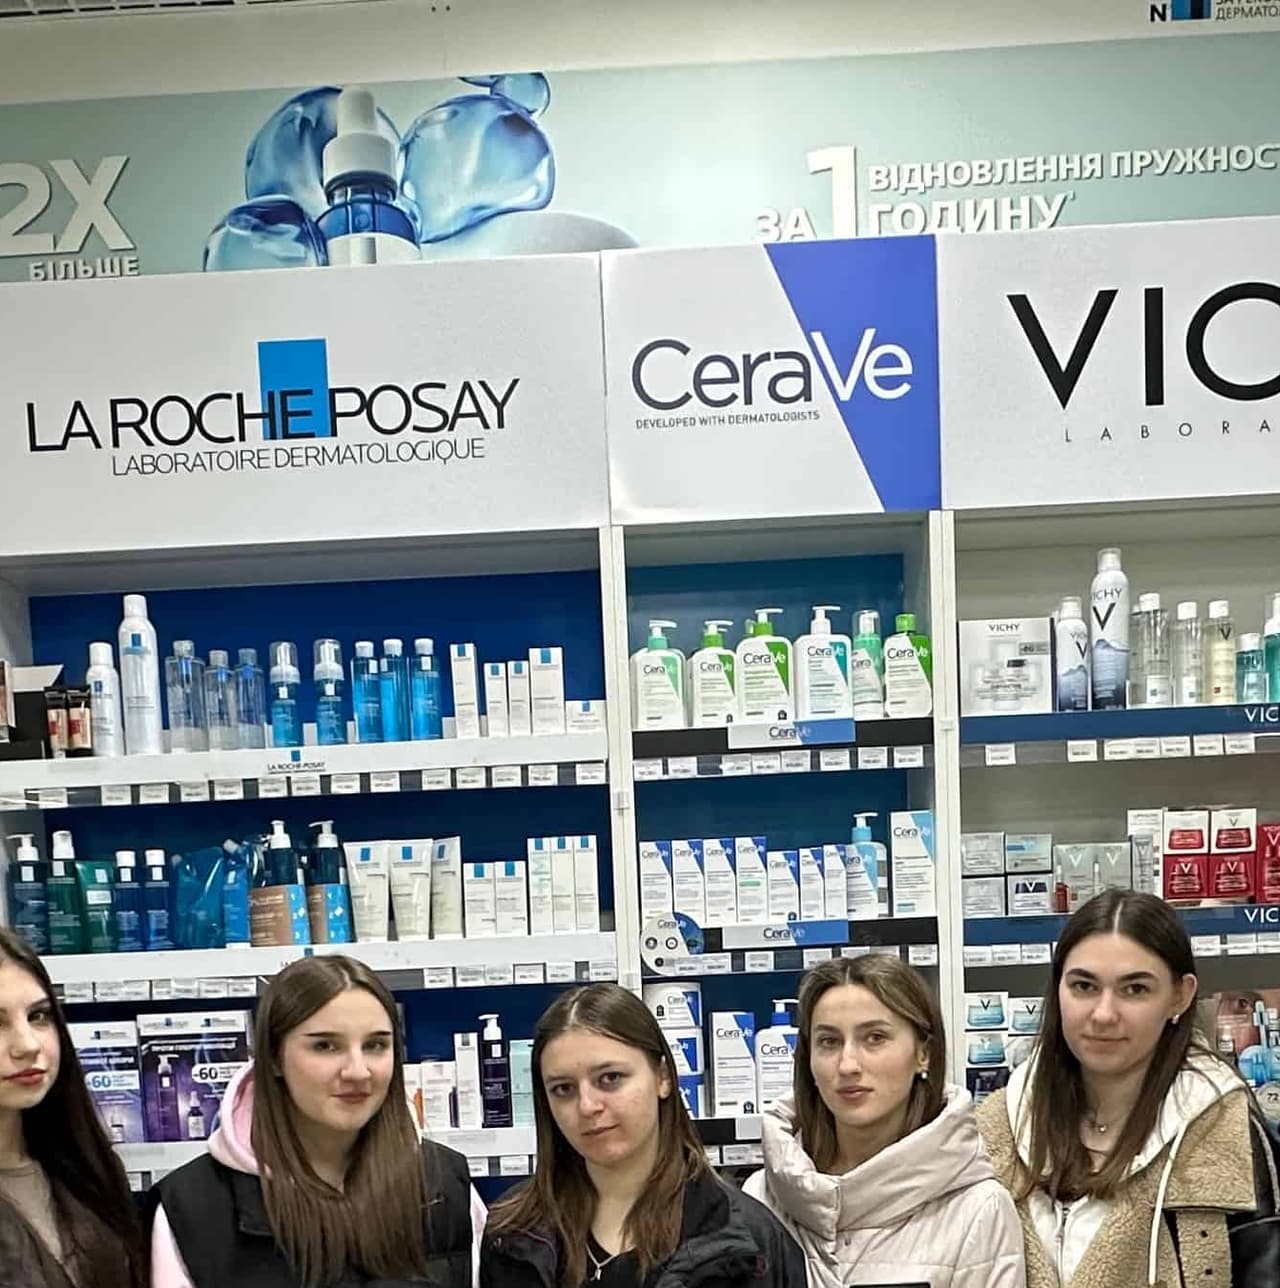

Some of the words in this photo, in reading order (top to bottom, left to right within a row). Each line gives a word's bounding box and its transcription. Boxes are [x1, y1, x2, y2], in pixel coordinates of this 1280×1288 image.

[867, 152, 1104, 195] ВІДНОВЛЕННЯ
[806, 144, 858, 238] 1
[28, 255, 140, 282] БІЛЬШЕ
[631, 327, 914, 411] CeraVe
[25, 400, 103, 453] LA
[109, 386, 317, 449] ROCHE
[326, 377, 521, 438] POSAY
[635, 418, 697, 430] DEVELOPED
[698, 415, 726, 427] WITH
[727, 409, 821, 426] DERMATOLOGISTS
[112, 447, 272, 477] LABORATOIRE
[274, 437, 487, 470] DERMATOLOGIQUE
[988, 623, 1020, 632] VICHY
[743, 652, 786, 665] CeraVe
[887, 647, 928, 659] CeraVe
